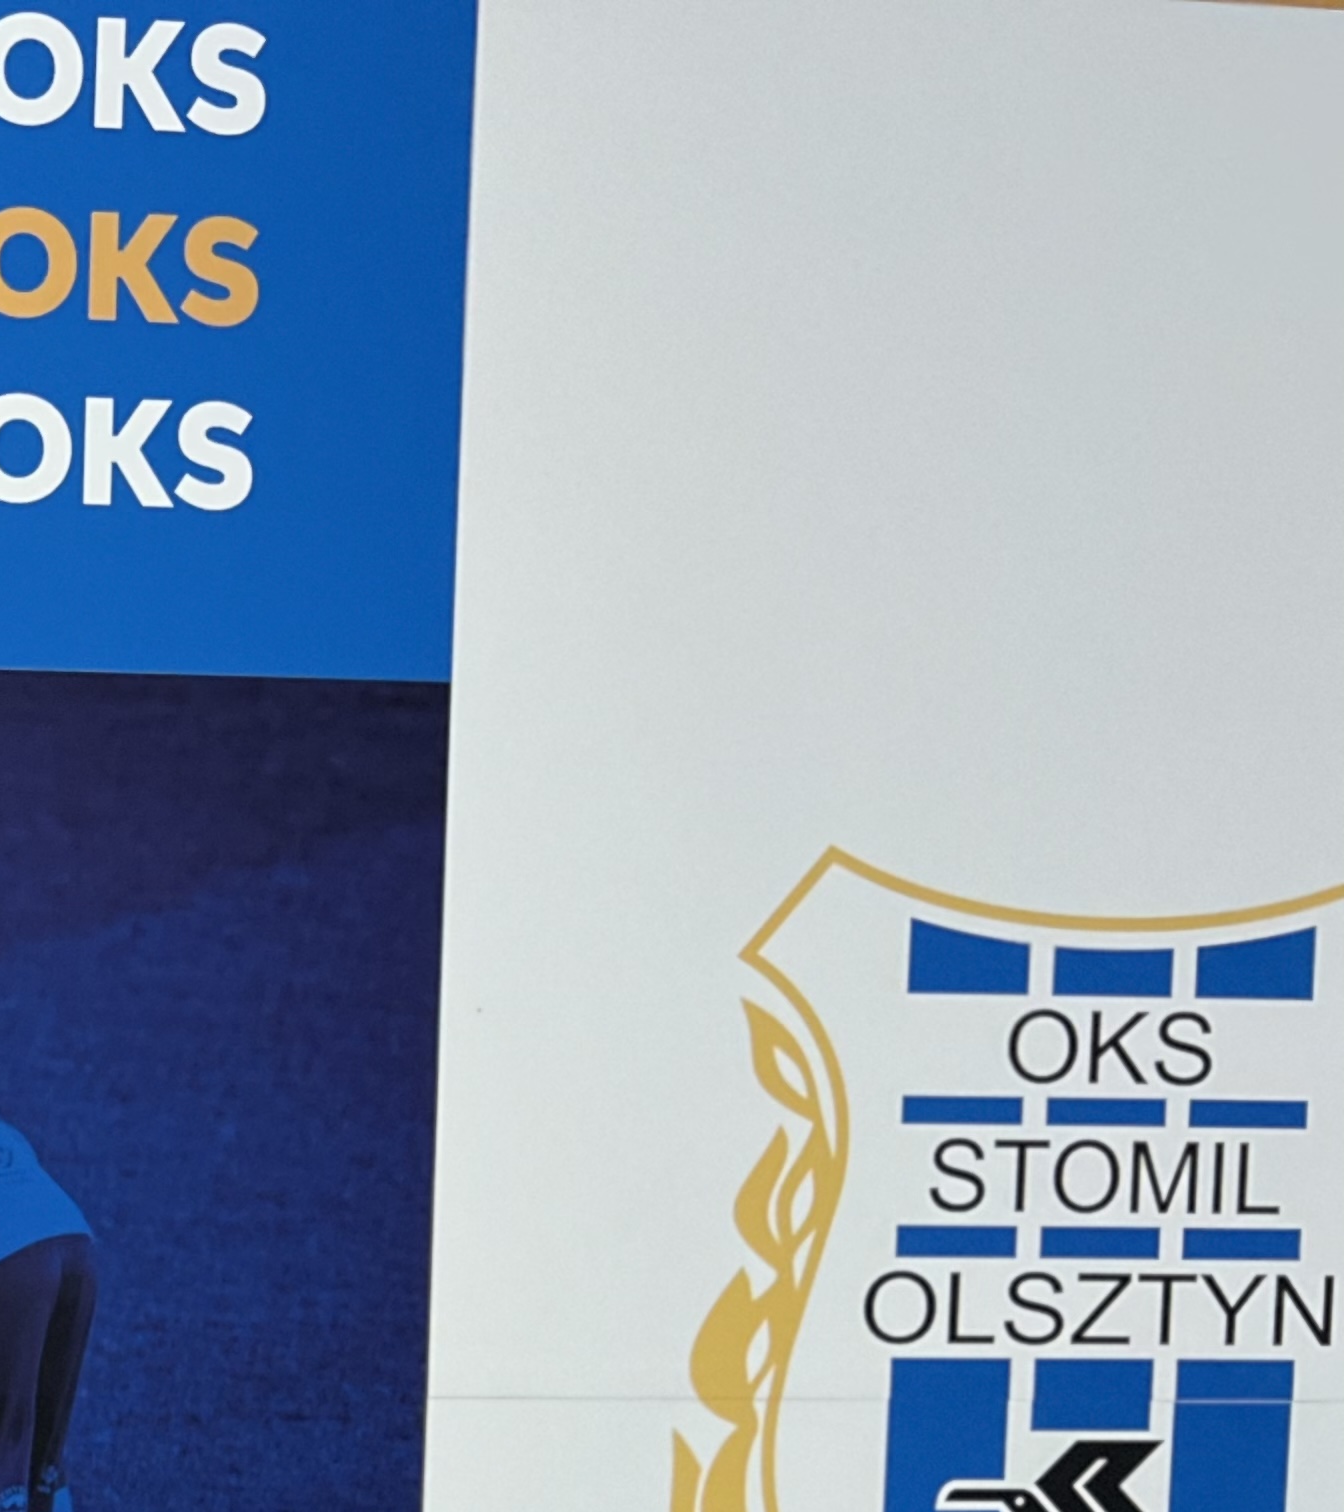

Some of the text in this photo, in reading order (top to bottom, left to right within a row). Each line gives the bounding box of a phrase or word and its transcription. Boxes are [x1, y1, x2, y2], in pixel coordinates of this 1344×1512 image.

[1008, 1008, 1213, 1086] OKS
[929, 1138, 1280, 1214] STOMIL
[864, 1270, 1334, 1346] OLSZTYN
